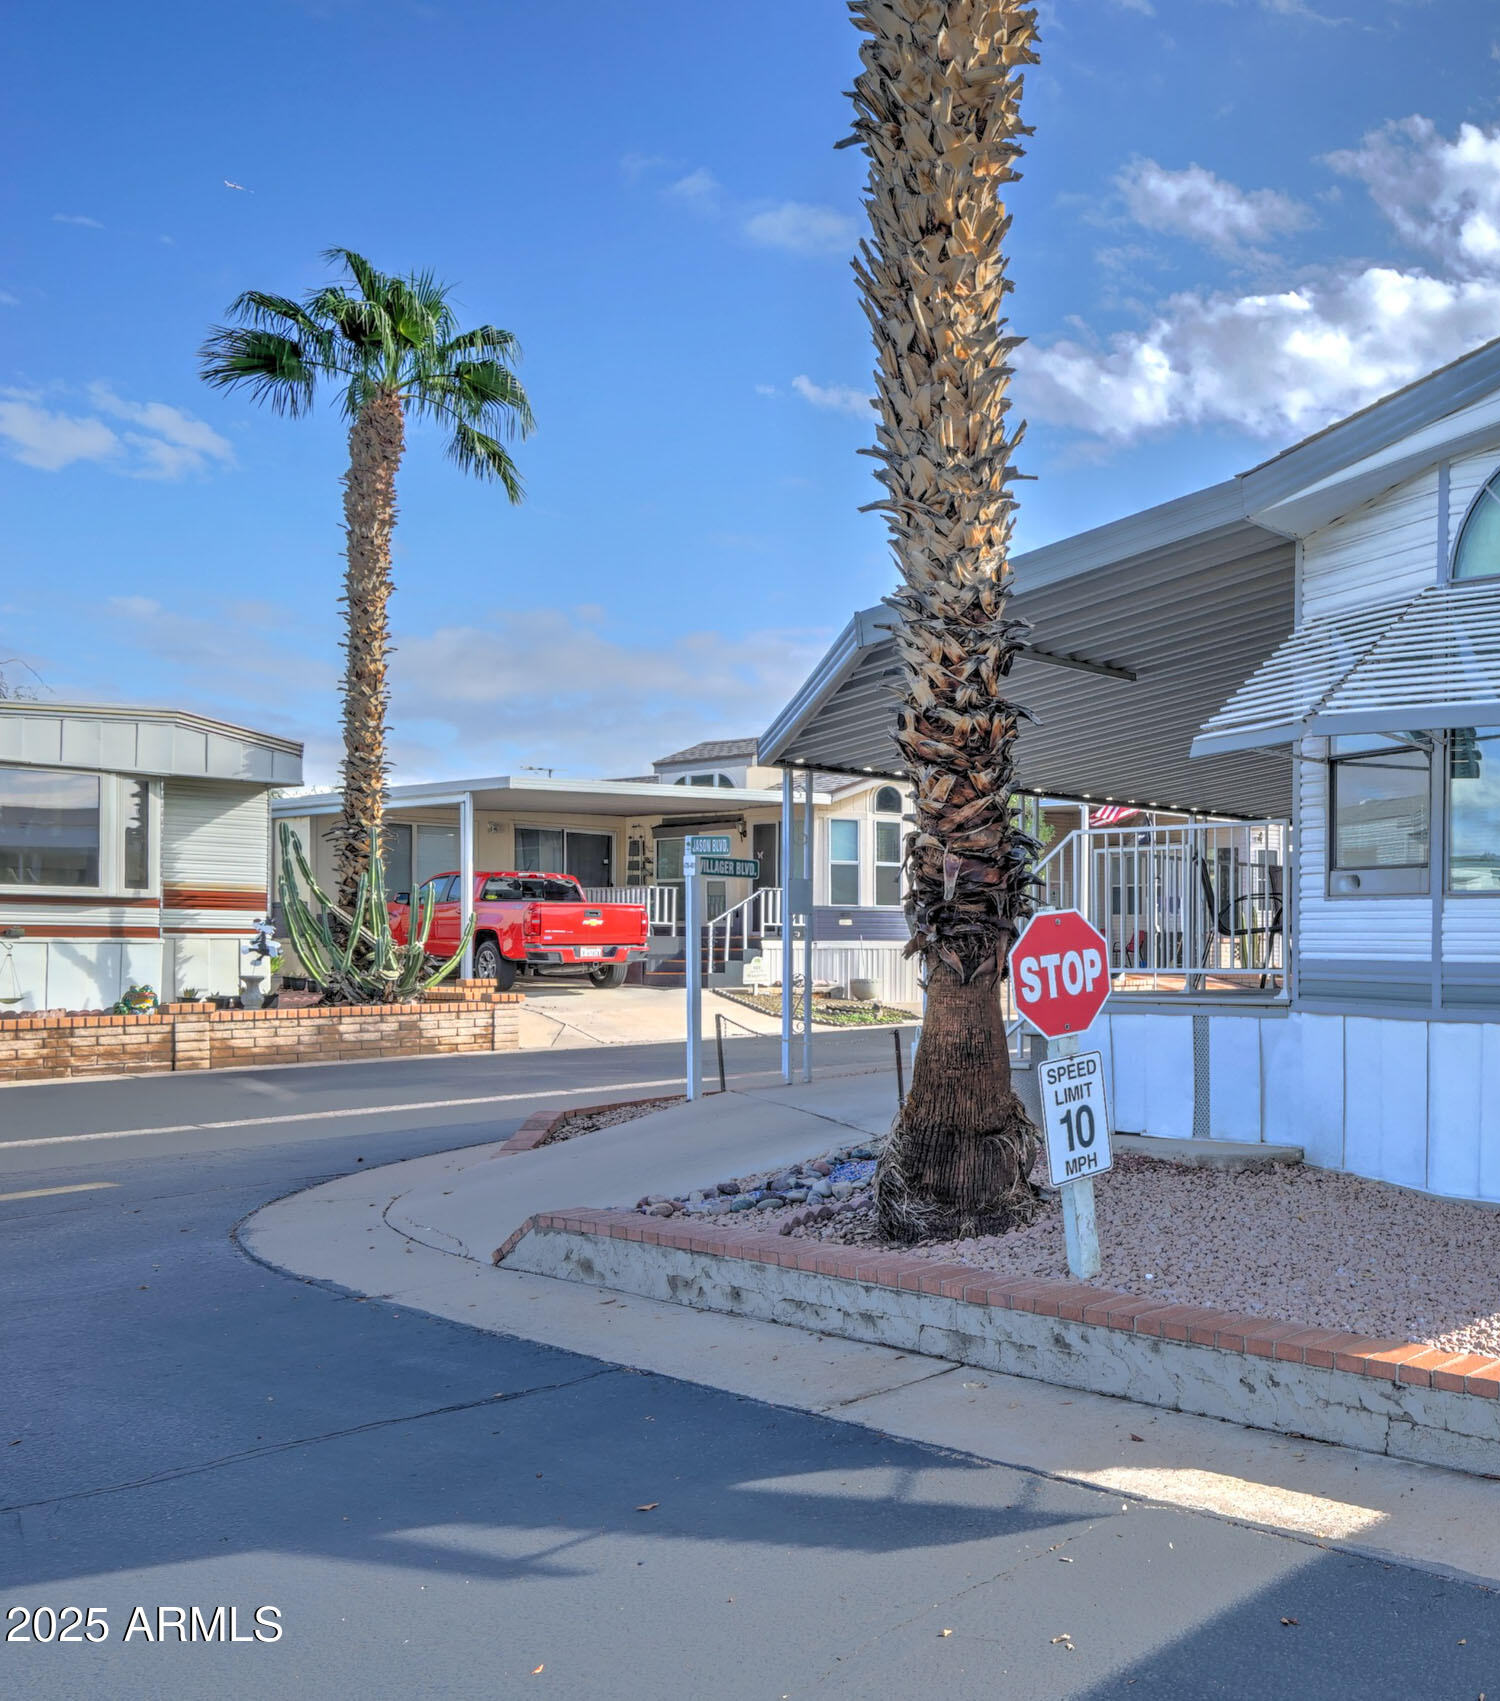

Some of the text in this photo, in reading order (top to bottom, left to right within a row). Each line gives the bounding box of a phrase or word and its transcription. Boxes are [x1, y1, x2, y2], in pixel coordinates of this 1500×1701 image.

[692, 839, 729, 852] JASON BLVD.
[735, 861, 757, 876] BLVD.
[1020, 948, 1102, 1003] STOP
[1046, 1058, 1097, 1086] SPEED
[1054, 1081, 1093, 1106] LIMIT
[1059, 1104, 1096, 1152] 10
[1065, 1151, 1098, 1177] MPH
